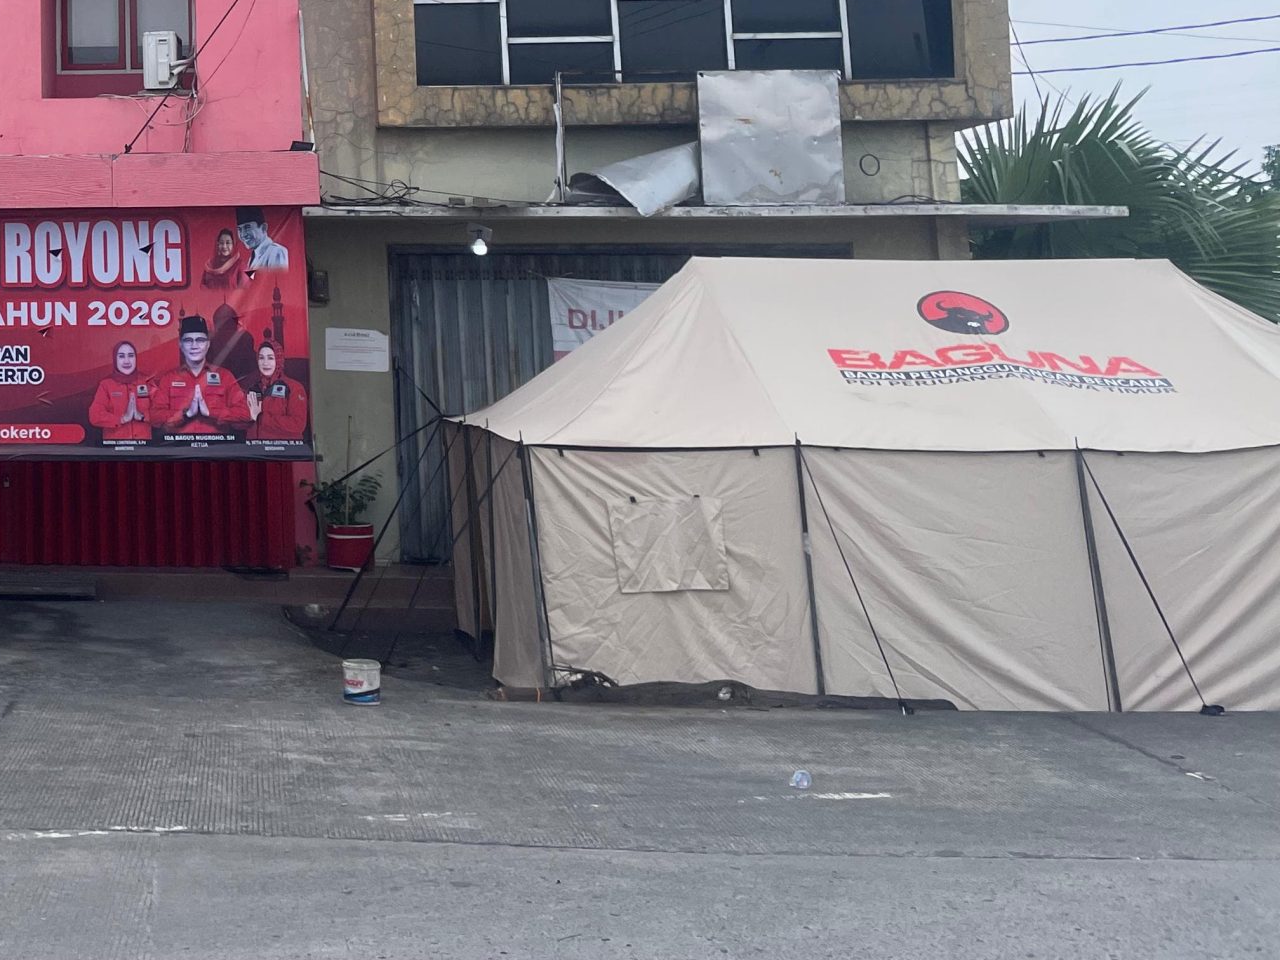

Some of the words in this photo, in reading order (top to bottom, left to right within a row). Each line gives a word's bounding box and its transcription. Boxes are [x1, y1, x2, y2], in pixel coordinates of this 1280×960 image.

[4, 219, 183, 286] ROYONG
[87, 300, 171, 326] 2026
[827, 342, 1162, 377] BAGUNA
[843, 370, 906, 381] BADAN
[910, 364, 1080, 383] PENANGGULANGAN
[1082, 376, 1169, 388] BENCANA
[845, 378, 882, 387] PDI
[889, 371, 1035, 387] PERJUANGAN
[1043, 376, 1100, 392] JAWA
